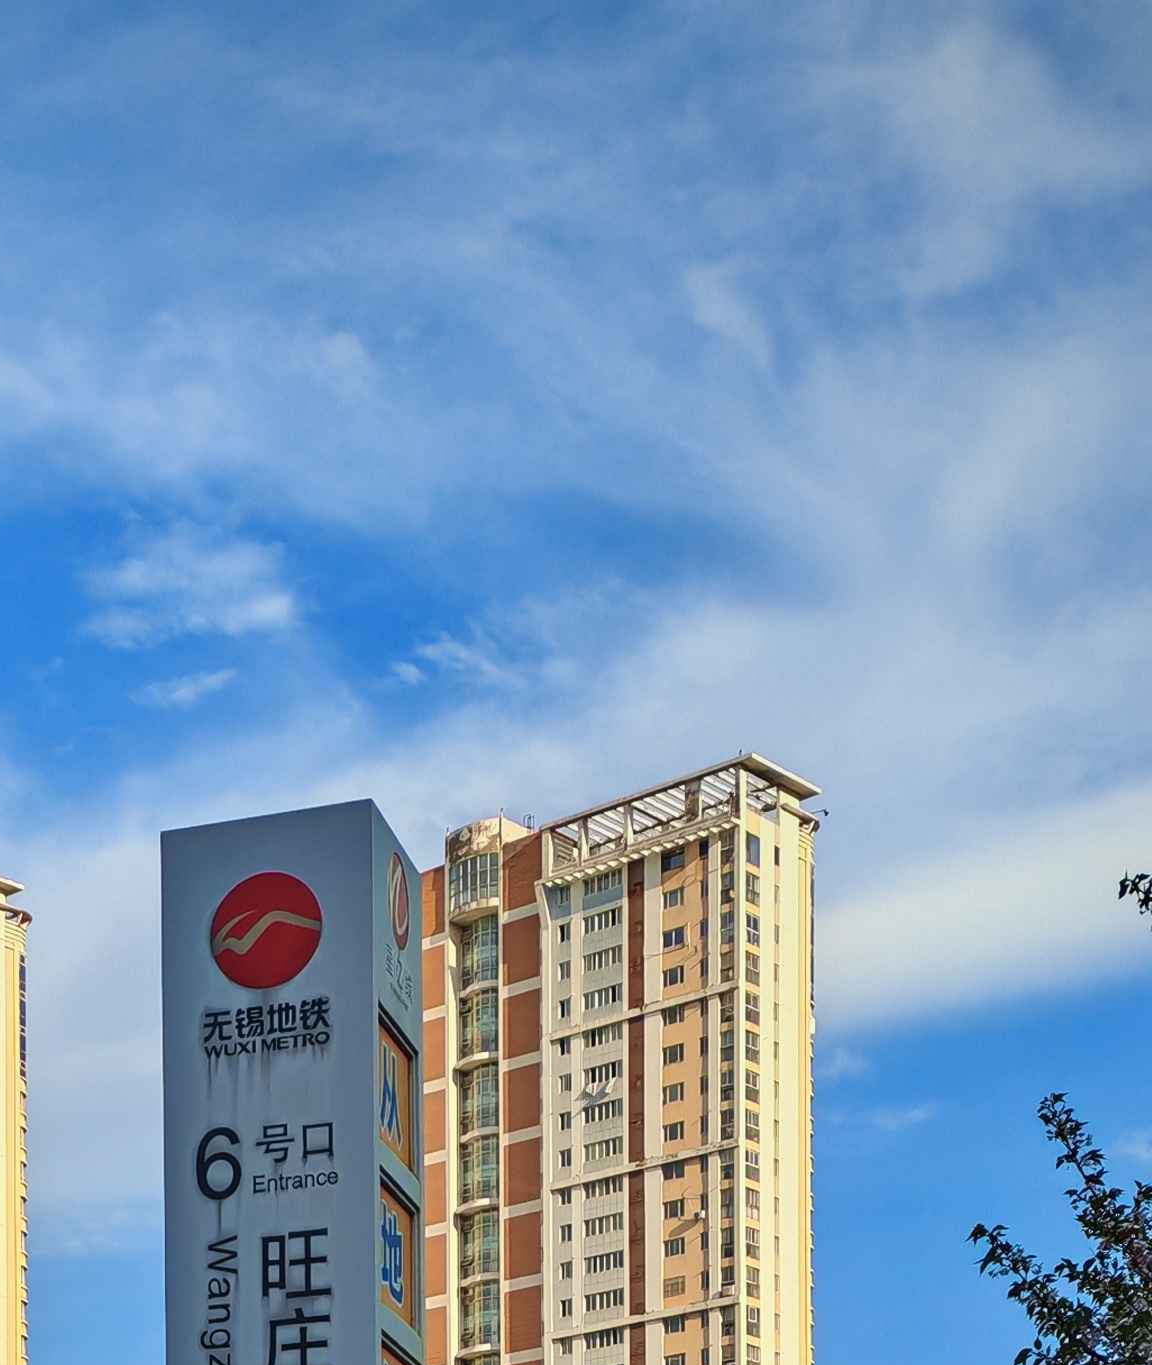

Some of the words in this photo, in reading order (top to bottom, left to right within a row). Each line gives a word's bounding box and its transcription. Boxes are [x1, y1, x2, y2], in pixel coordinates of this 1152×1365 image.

[203, 998, 329, 1043] 无锡地铁
[204, 1040, 256, 1058] WUXI
[261, 1031, 330, 1053] METRO
[195, 1127, 242, 1200] 6
[256, 1122, 335, 1164] 号口
[252, 1169, 338, 1195] Entrance
